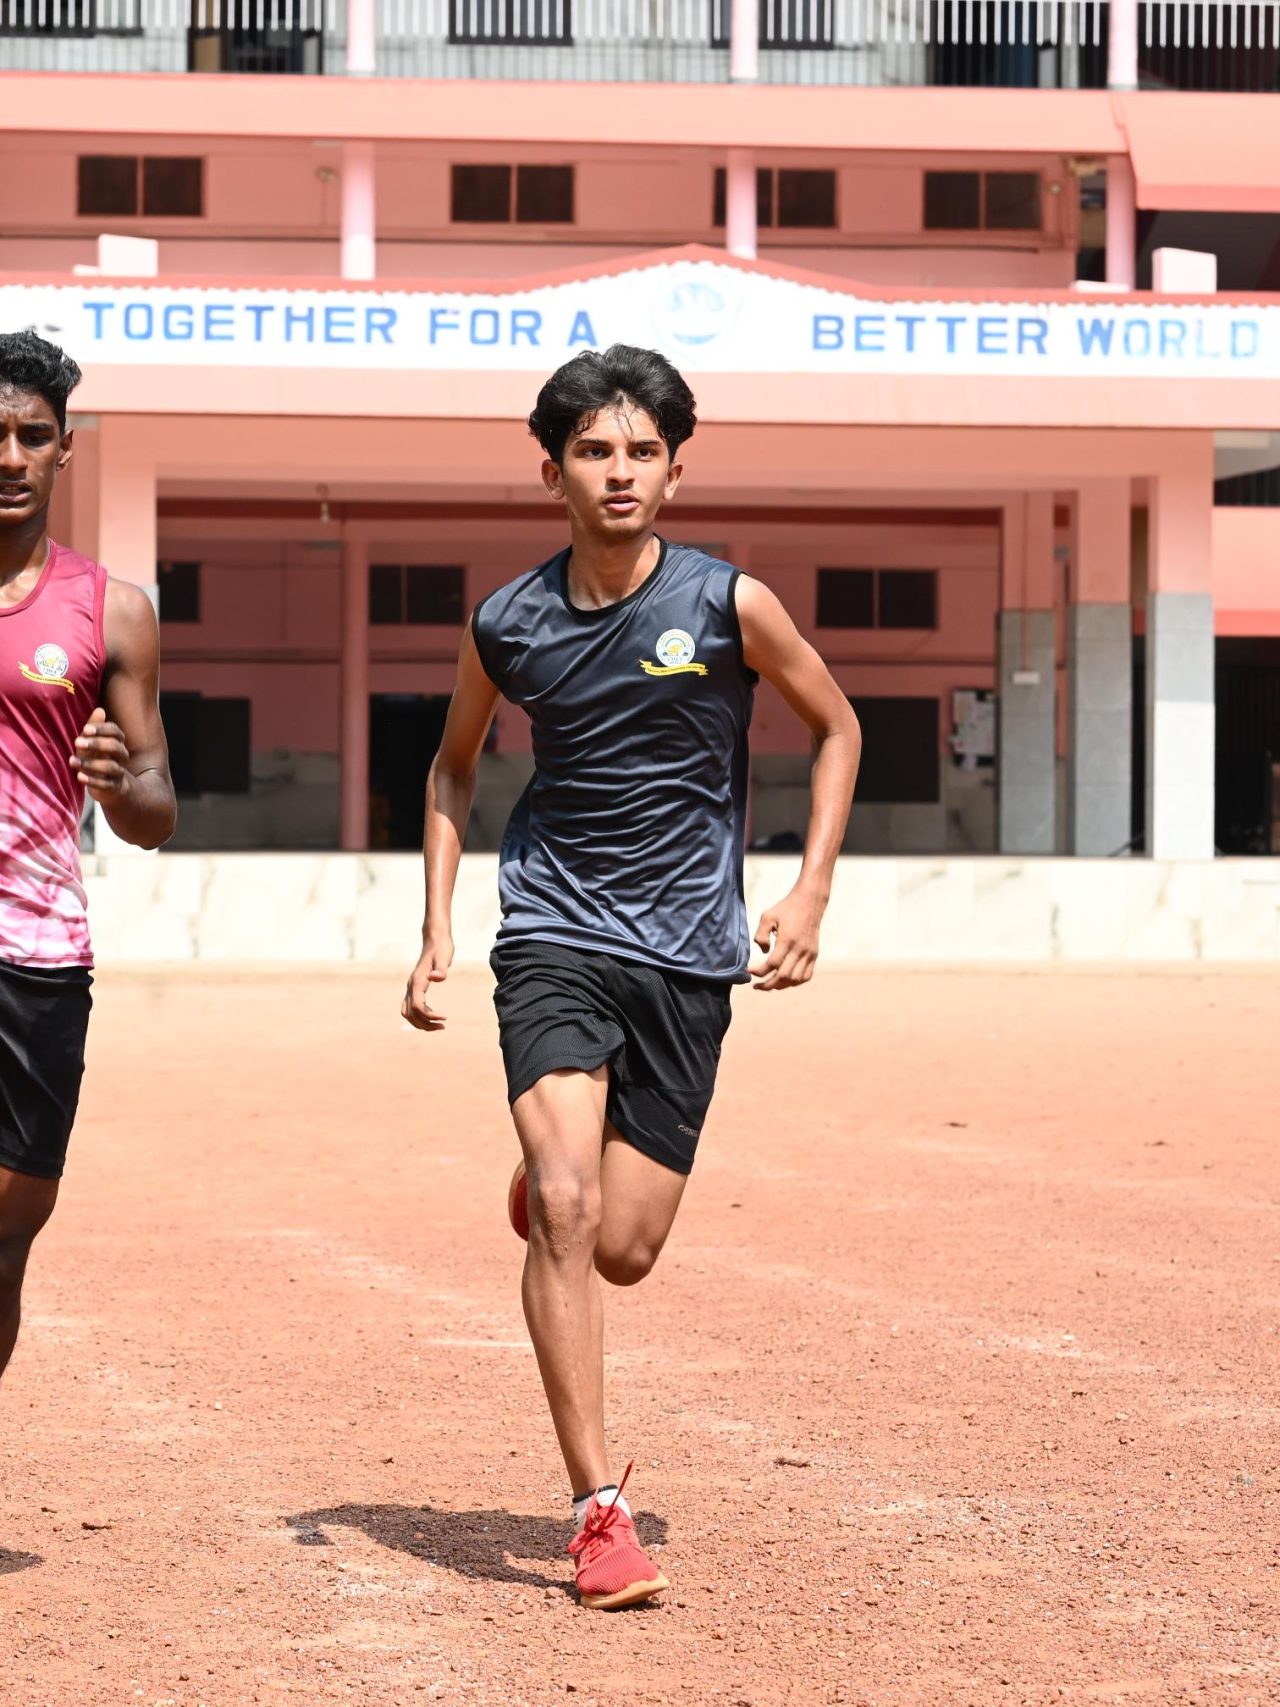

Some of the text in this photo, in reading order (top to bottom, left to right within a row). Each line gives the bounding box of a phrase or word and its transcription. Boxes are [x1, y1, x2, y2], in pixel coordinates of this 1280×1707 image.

[82, 301, 1260, 359] TOGETHER FOR A BETTER WORLD
